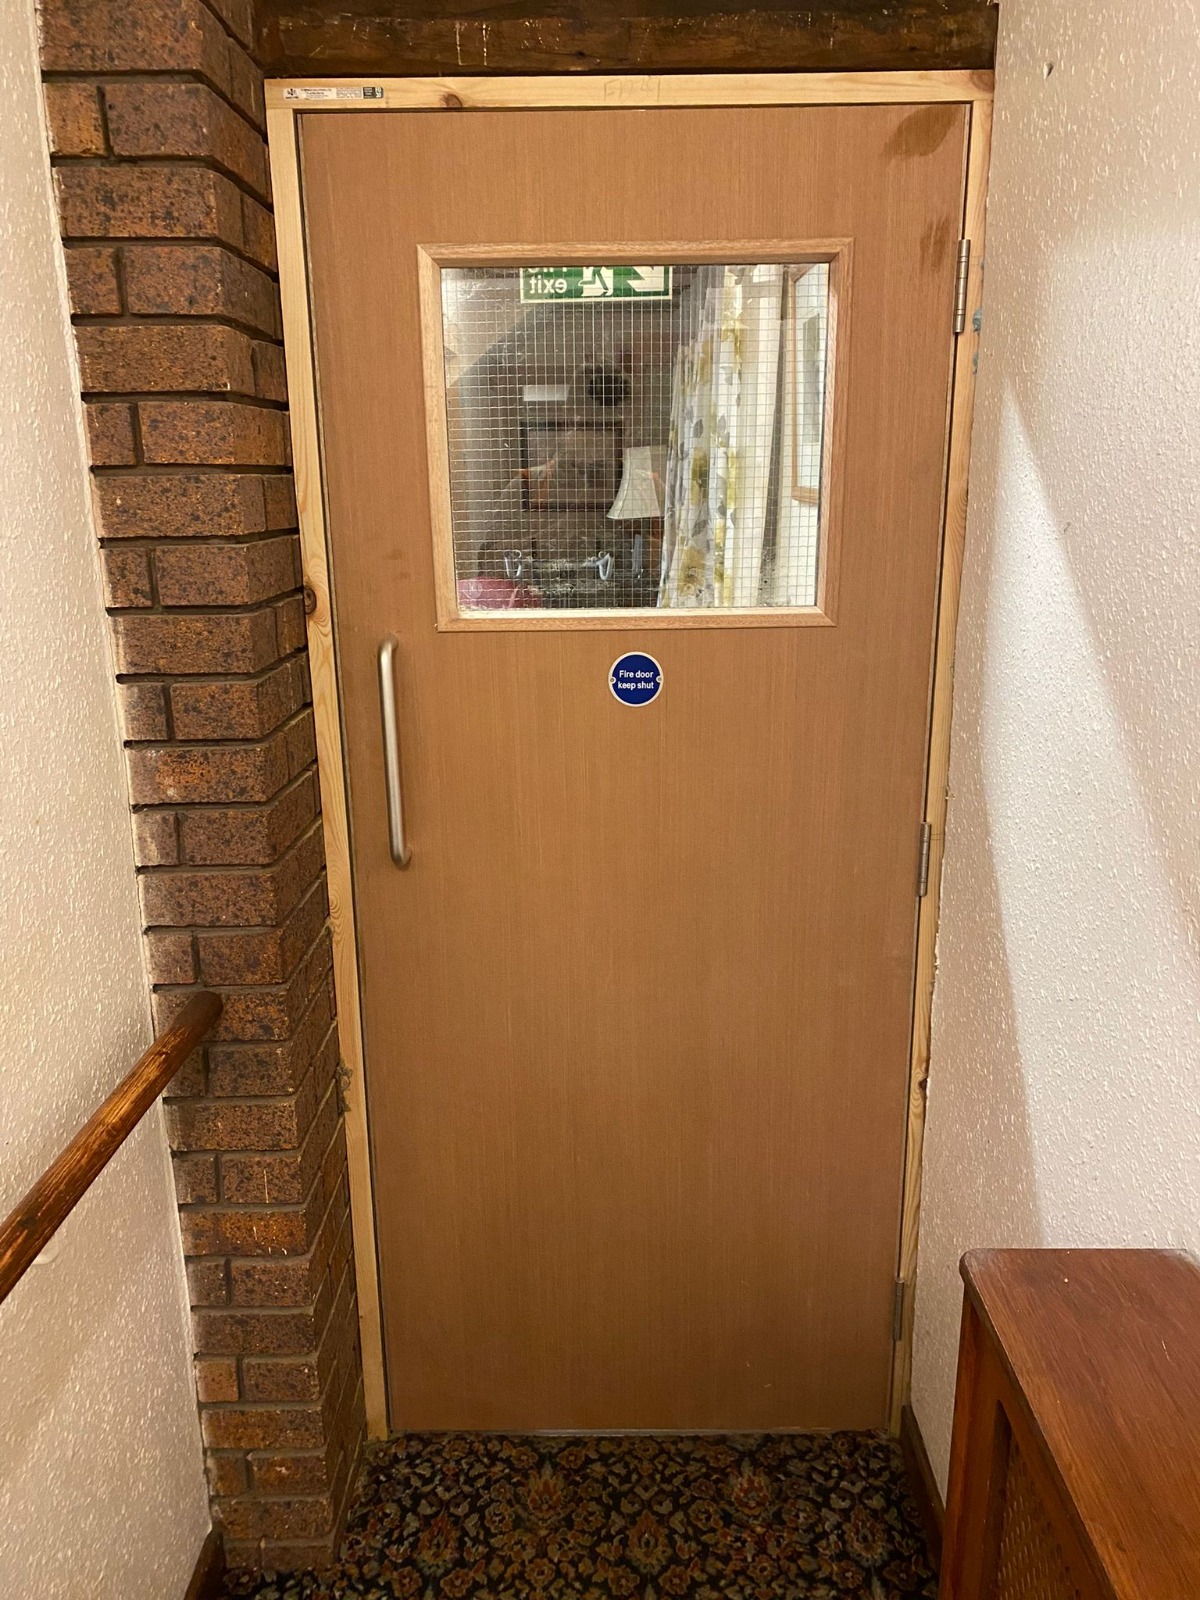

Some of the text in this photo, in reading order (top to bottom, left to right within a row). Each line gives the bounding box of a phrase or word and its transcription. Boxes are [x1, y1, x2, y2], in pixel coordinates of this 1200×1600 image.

[619, 670, 654, 678] Fire door
[617, 681, 654, 690] keep shut
